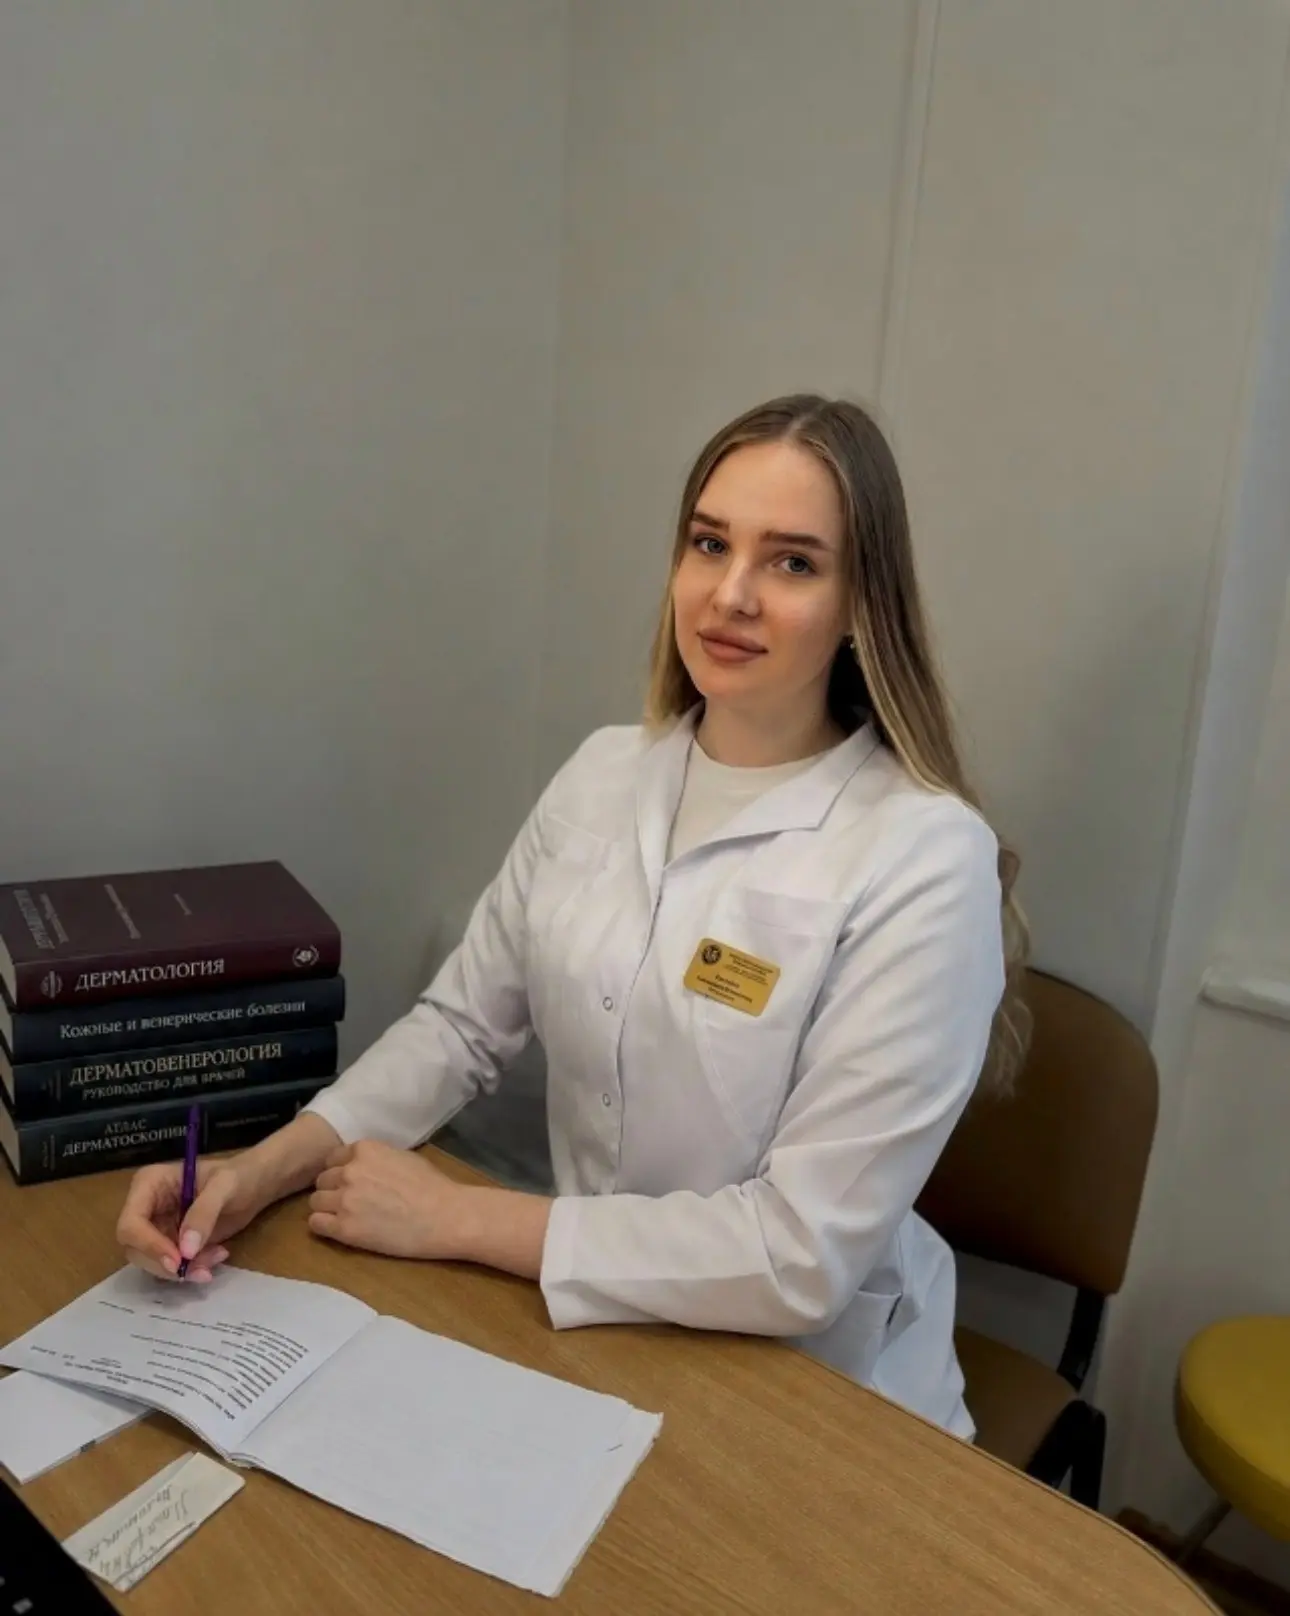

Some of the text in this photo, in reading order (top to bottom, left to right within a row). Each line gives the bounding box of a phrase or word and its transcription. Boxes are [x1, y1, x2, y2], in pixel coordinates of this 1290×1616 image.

[74, 958, 225, 992] ДЕРМАТОЛОГИЯ
[60, 1001, 306, 1039] Кожные и венерические болезни
[69, 1042, 282, 1087] ДЕРМАТОВЕНЕРОЛОГИЯ
[62, 1125, 188, 1157] ДЕРМАТОСКОПИИ
[104, 1119, 148, 1136] АТЛАС
